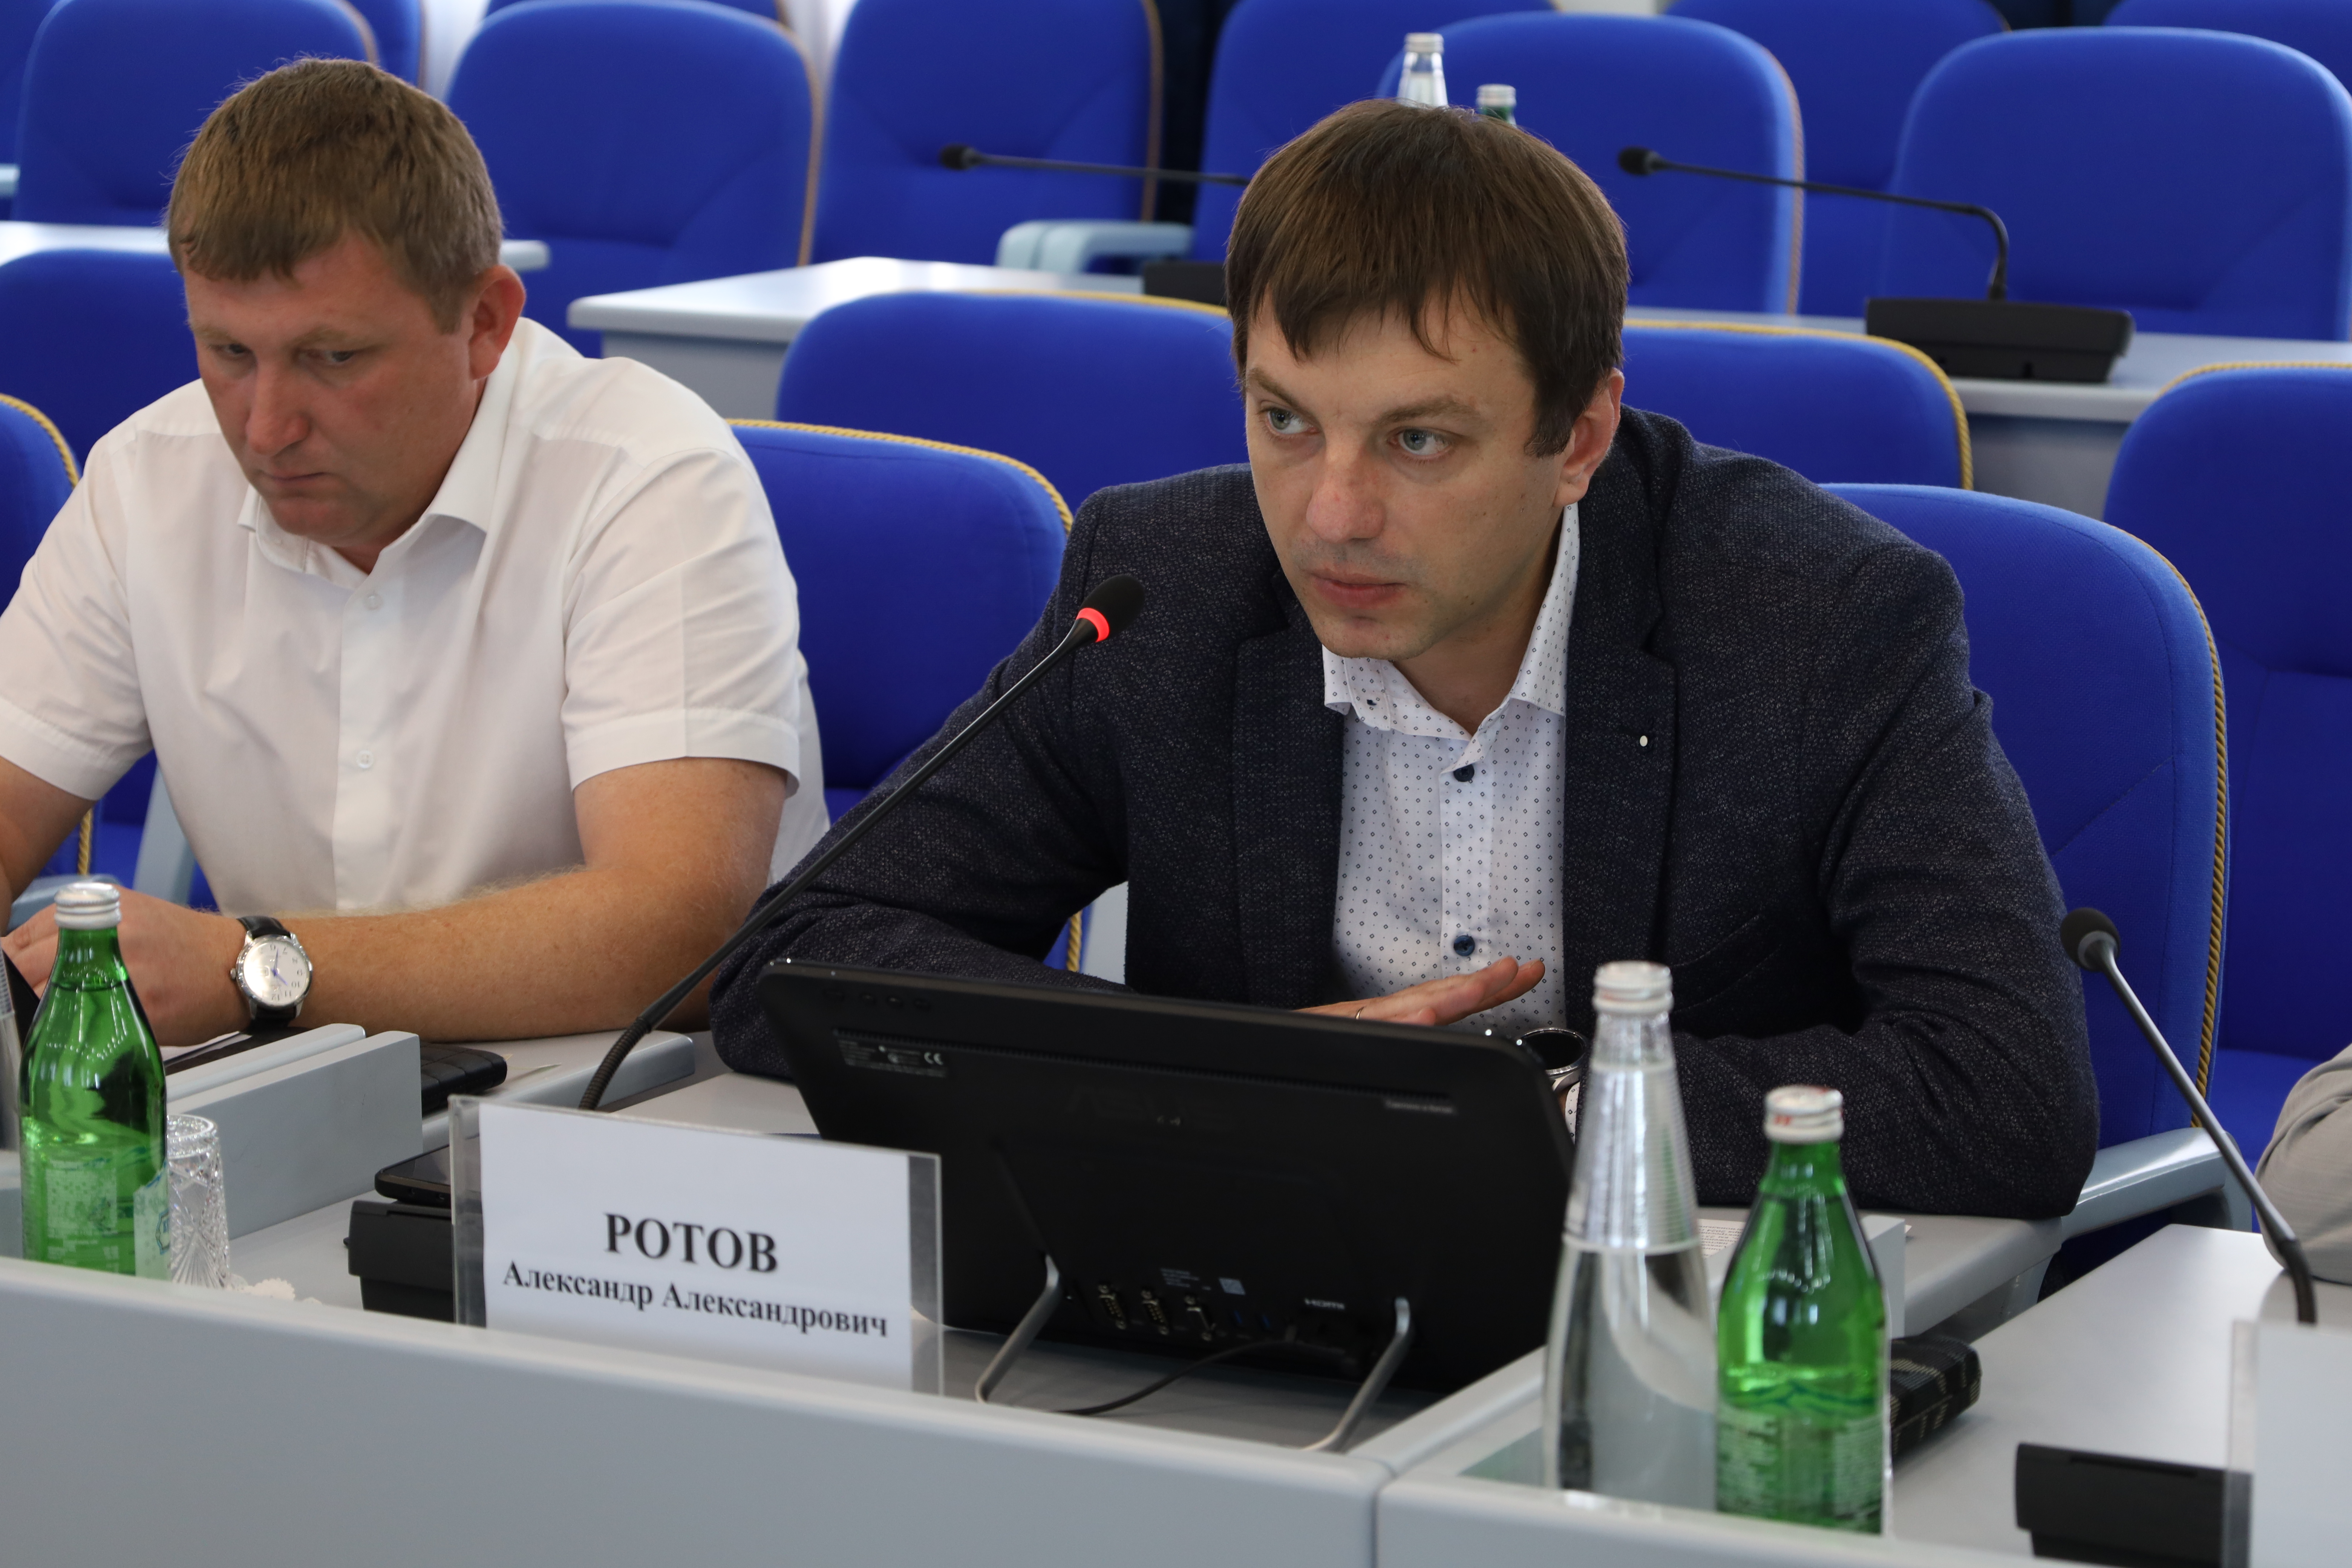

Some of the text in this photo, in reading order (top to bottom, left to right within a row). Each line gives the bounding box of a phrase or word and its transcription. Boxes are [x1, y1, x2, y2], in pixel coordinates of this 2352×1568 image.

[605, 1213, 777, 1272] РОТОВ
[503, 1260, 887, 1337] Александр Александрович
